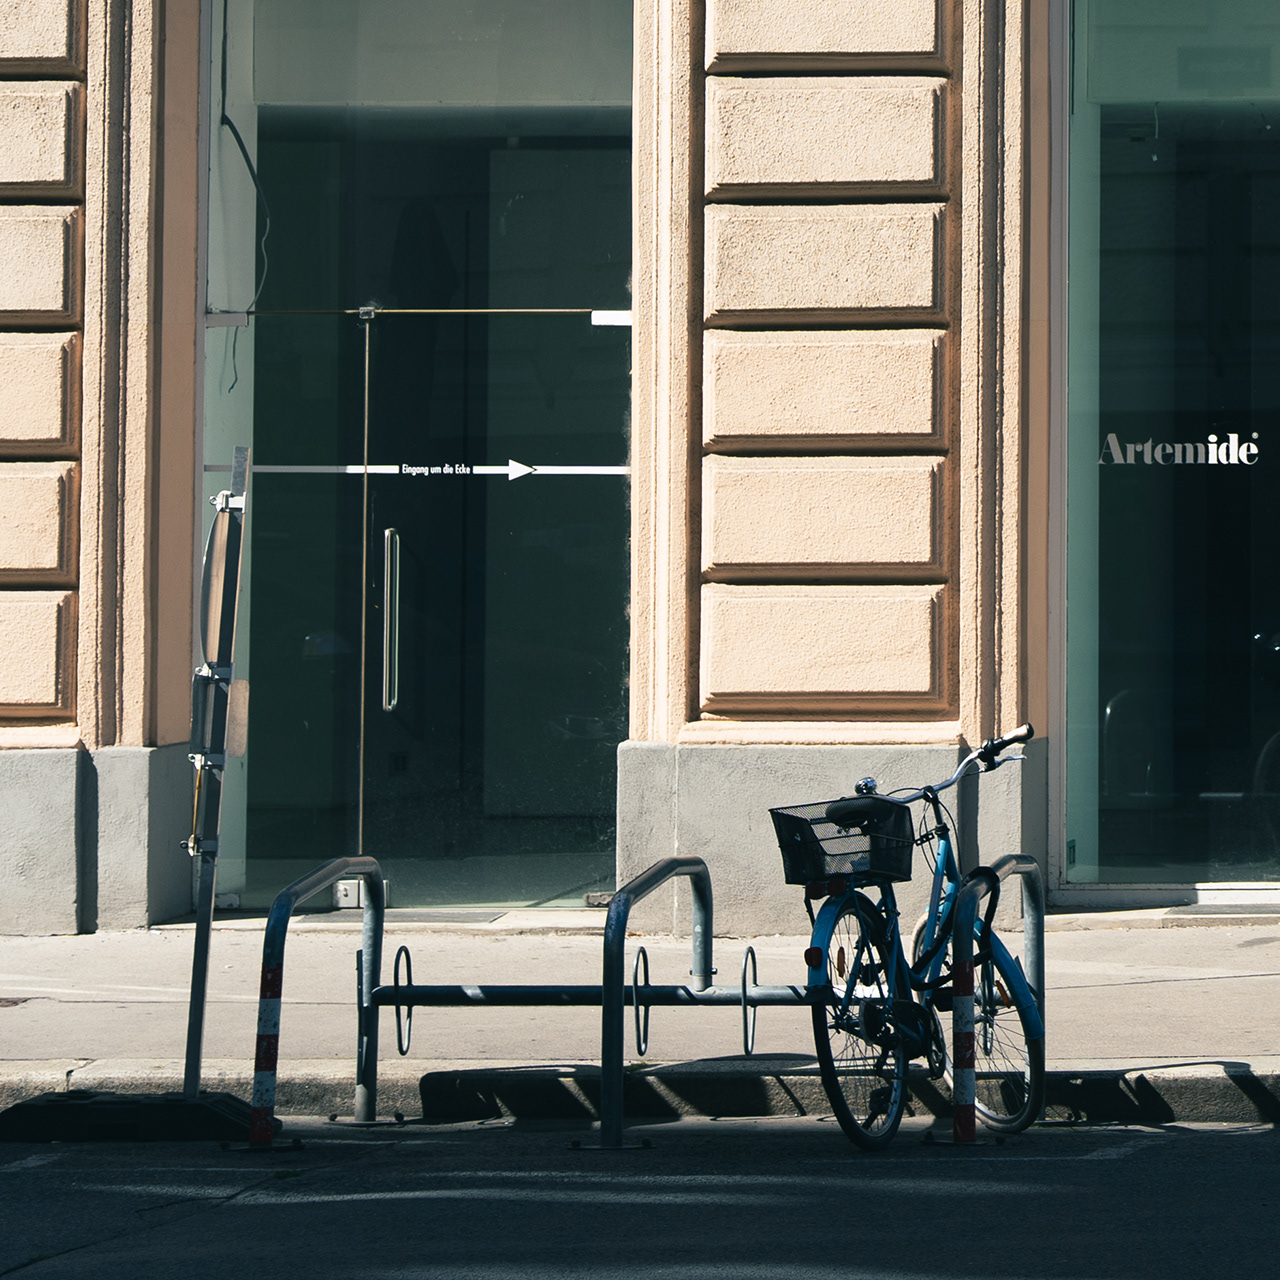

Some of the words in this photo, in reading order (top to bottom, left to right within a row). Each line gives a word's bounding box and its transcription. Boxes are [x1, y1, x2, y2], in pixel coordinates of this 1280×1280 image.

[1098, 432, 1260, 466] Artemide
[402, 463, 429, 476] Eingang
[430, 466, 442, 474] um
[442, 463, 454, 474] die
[455, 463, 471, 474] Ecke
